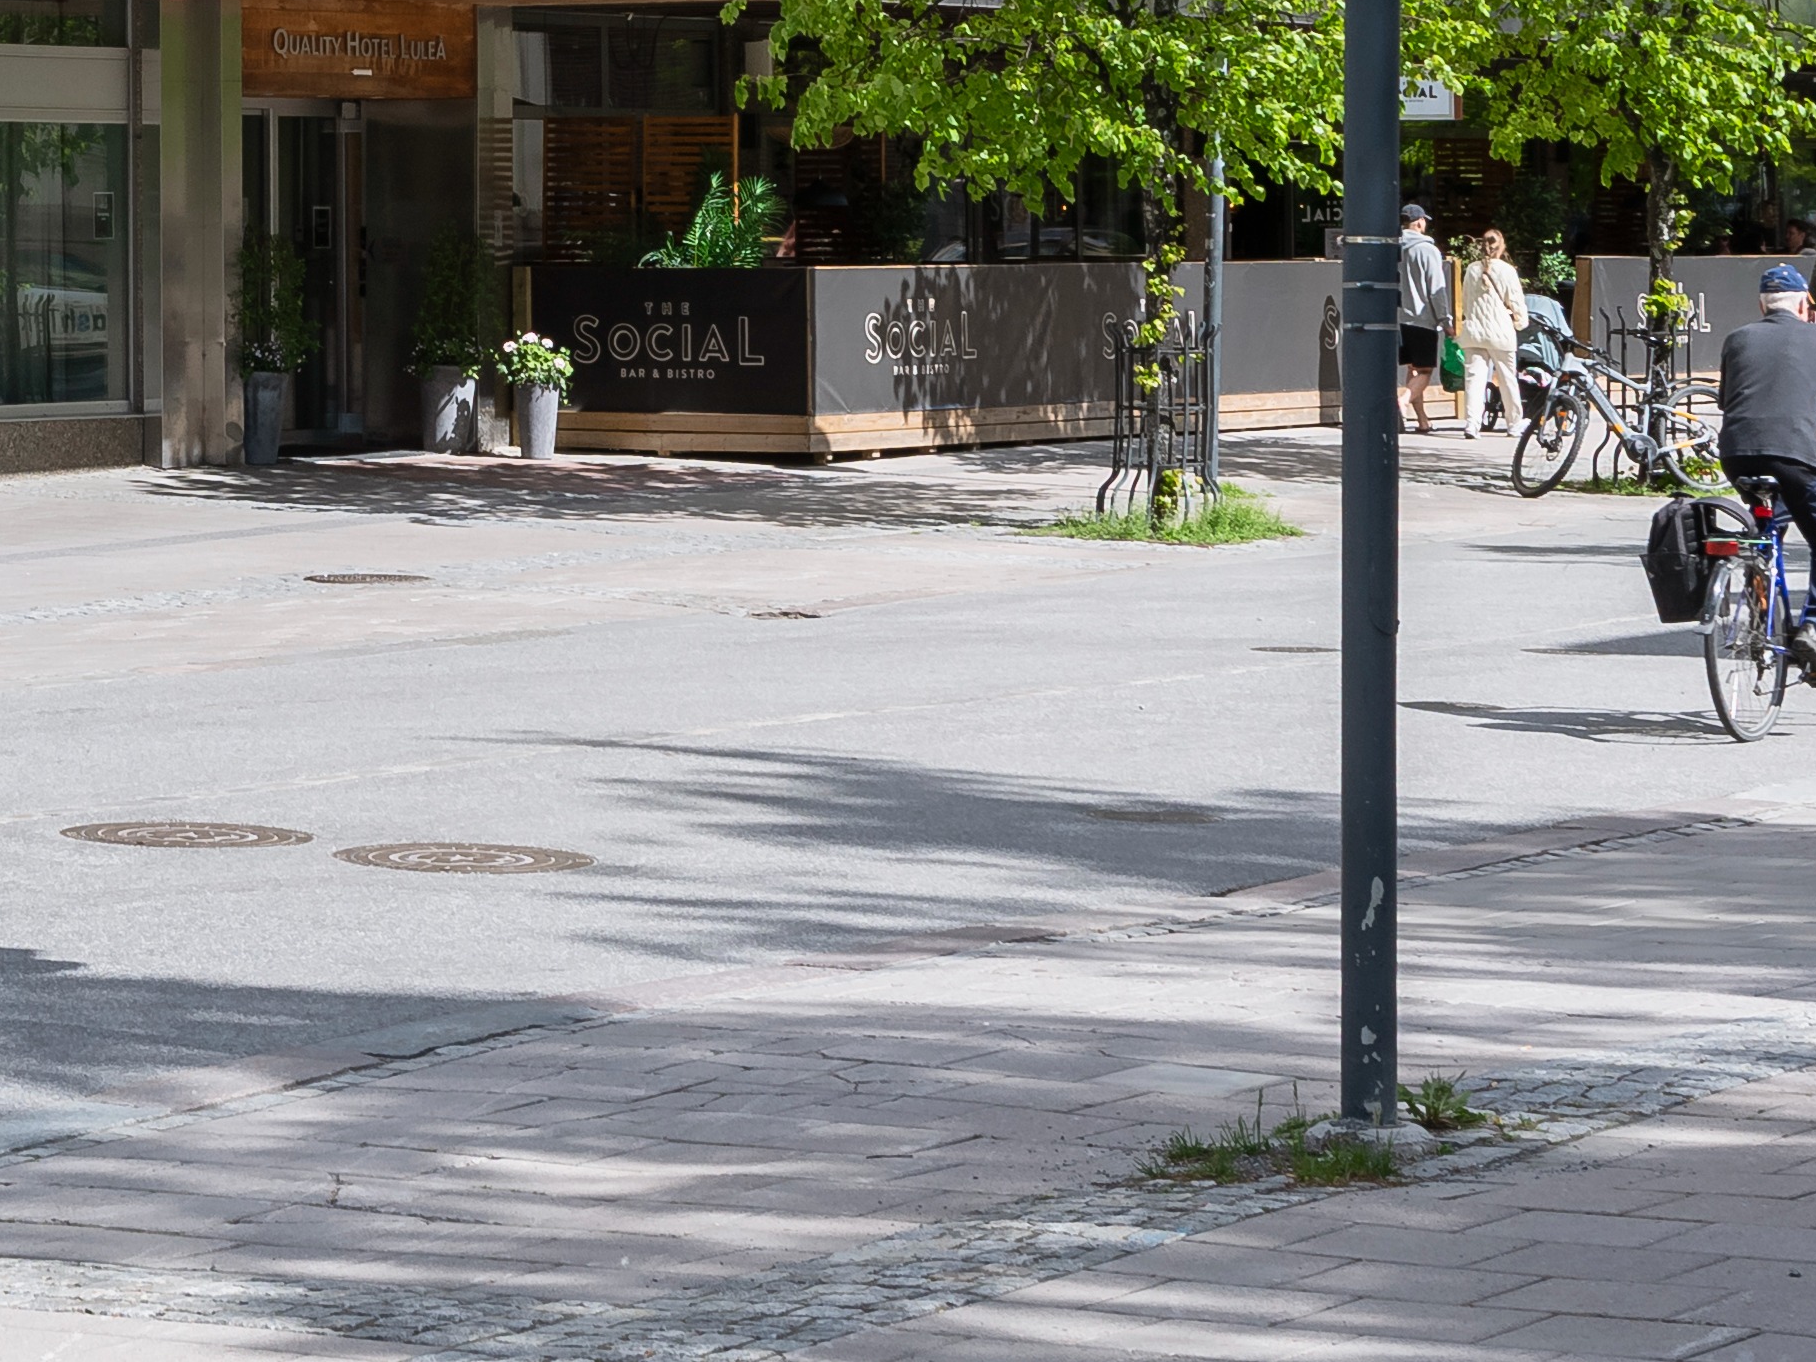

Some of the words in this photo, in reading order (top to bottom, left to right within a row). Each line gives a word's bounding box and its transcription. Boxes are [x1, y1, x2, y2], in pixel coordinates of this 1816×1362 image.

[273, 28, 341, 58] QUALITY
[346, 31, 396, 59] HOTEL
[400, 34, 446, 60] LULEÅ
[645, 302, 690, 315] THE
[573, 314, 764, 365] SOCIAL
[865, 311, 977, 364] SOCIAL
[620, 368, 645, 378] BAR
[652, 369, 660, 378] &
[667, 369, 716, 379] BISTRO
